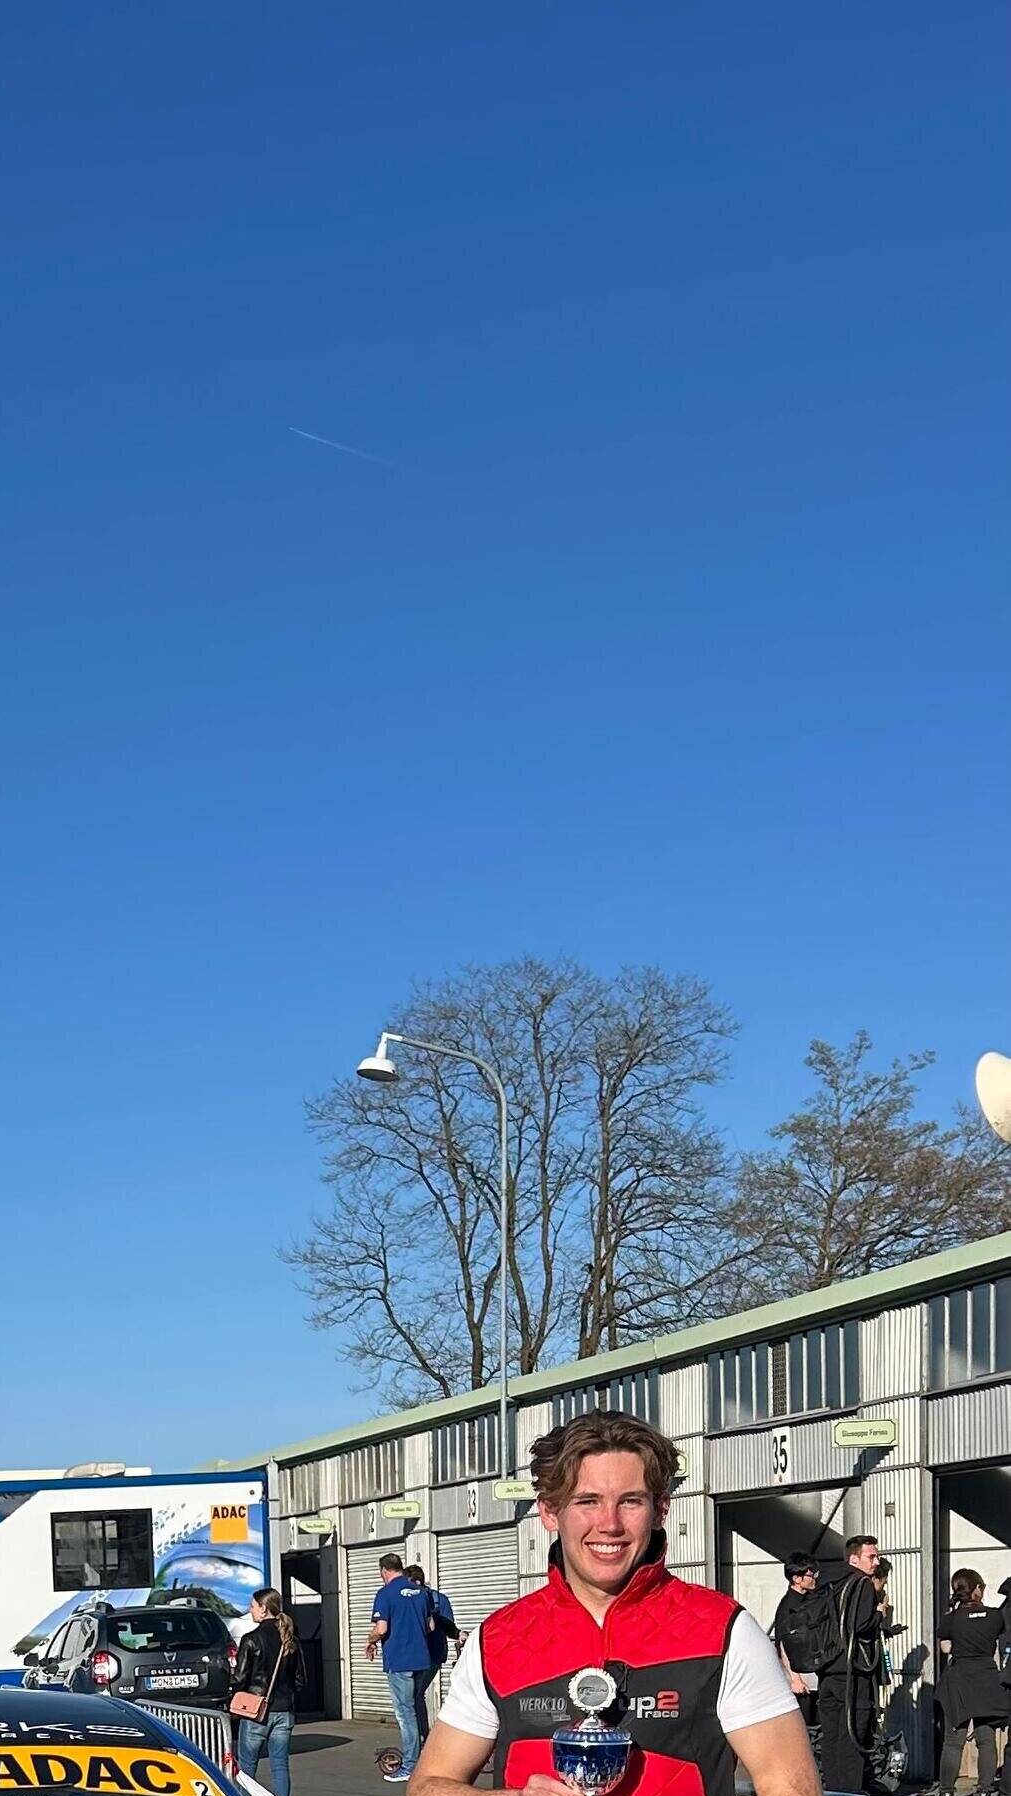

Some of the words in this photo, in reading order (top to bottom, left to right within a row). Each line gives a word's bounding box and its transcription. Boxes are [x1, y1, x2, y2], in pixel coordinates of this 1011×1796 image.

[773, 1435, 787, 1475] 35
[212, 1506, 246, 1520] ADAC
[519, 1698, 549, 1711] WERK
[644, 1710, 679, 1719] race
